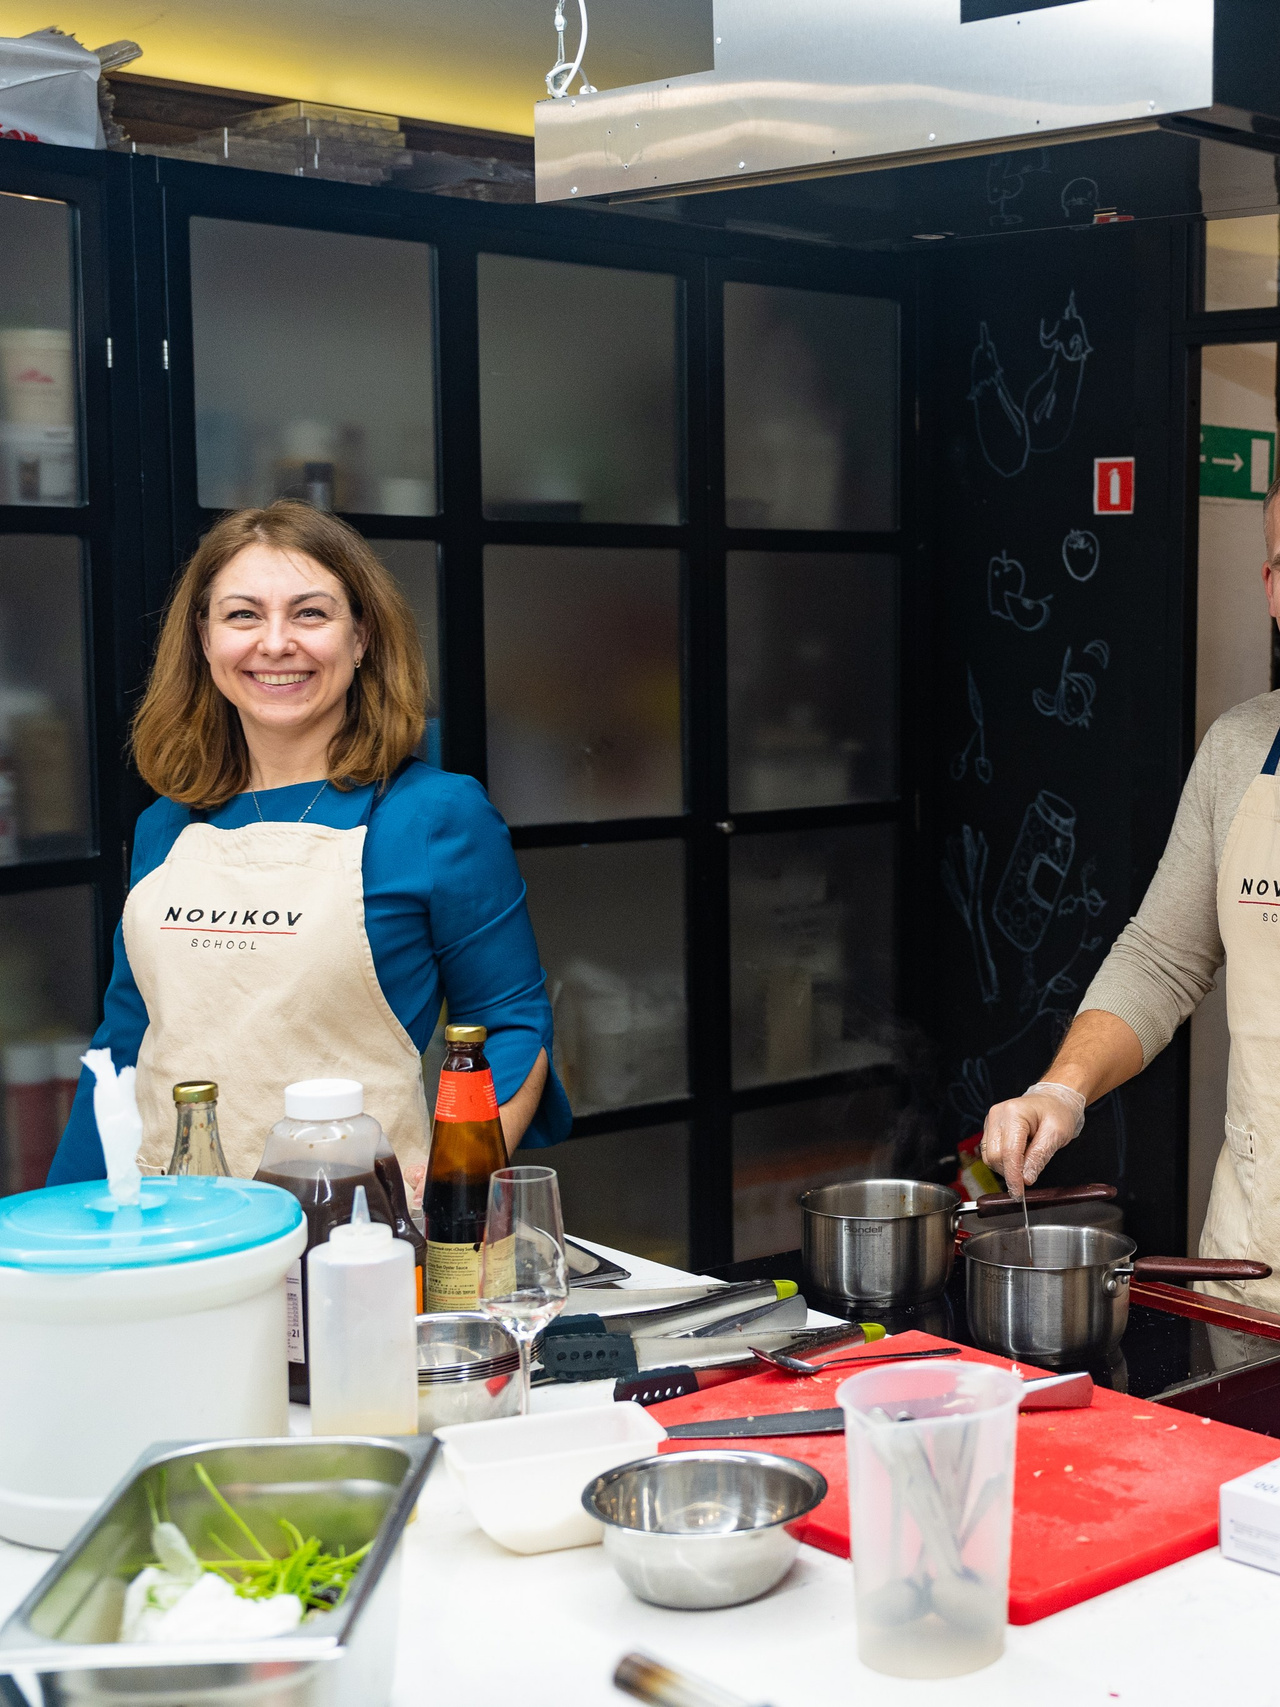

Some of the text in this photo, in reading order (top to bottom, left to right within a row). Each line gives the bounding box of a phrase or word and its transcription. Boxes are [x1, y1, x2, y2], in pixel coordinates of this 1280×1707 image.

[164, 906, 303, 927] NOVIKOV
[190, 938, 257, 950] SCHOOL
[844, 1225, 883, 1233] Rondell
